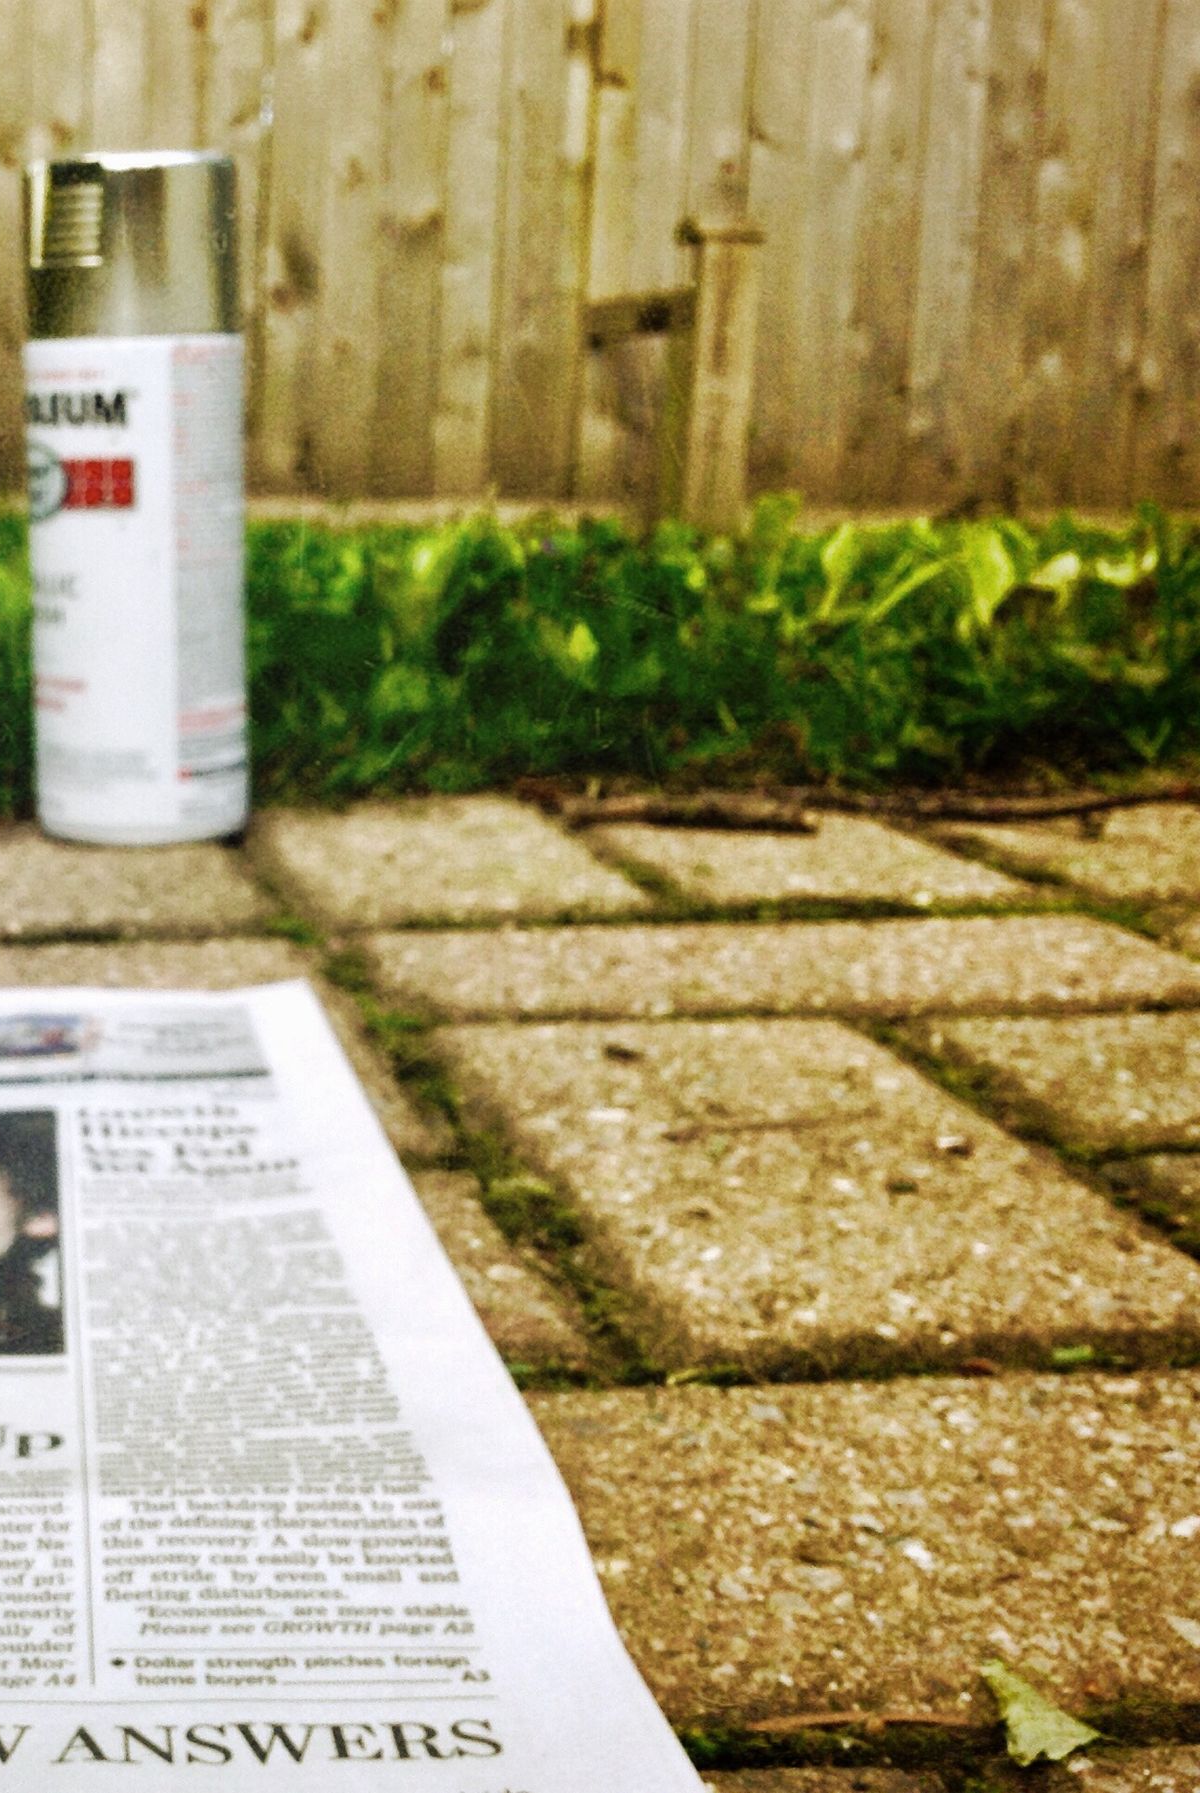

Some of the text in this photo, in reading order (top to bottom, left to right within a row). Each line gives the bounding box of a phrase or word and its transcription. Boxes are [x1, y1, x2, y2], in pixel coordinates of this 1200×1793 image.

[133, 1656, 195, 1669] Dollar
[205, 1655, 297, 1670] strength
[135, 1673, 197, 1686] home
[51, 1718, 505, 1766] ANSWERS
